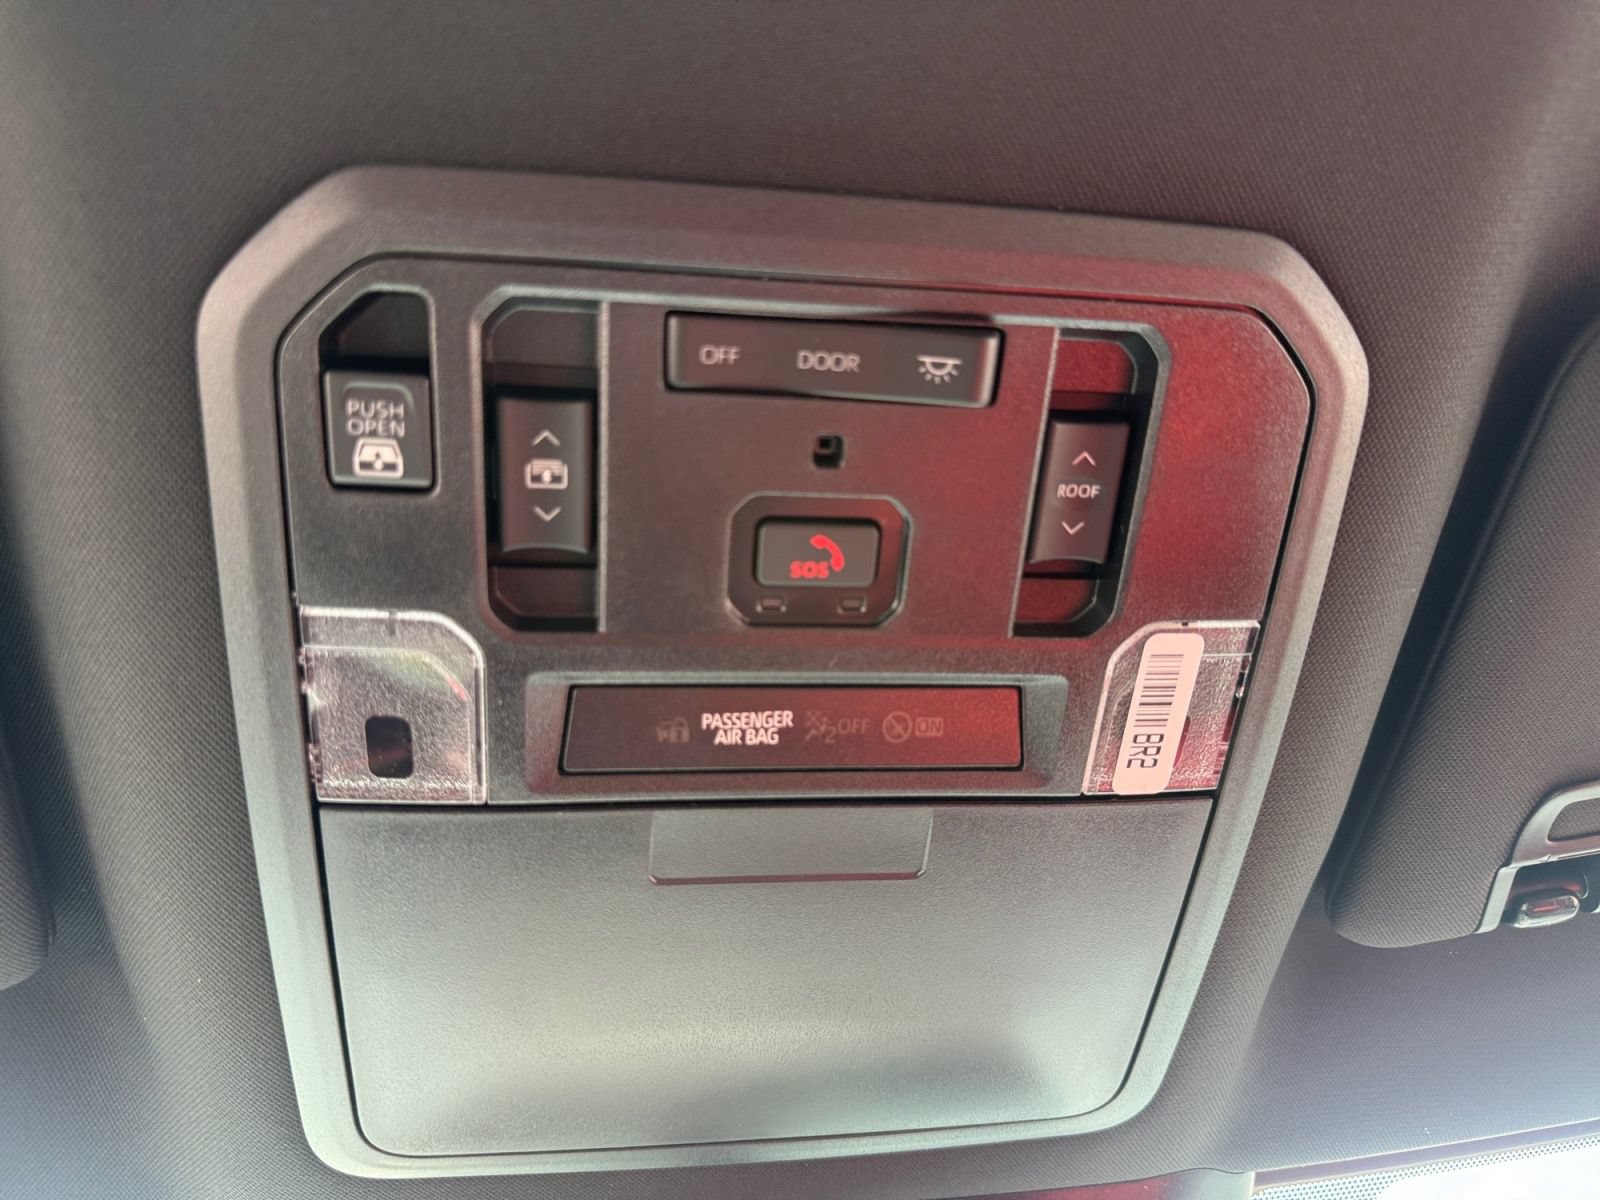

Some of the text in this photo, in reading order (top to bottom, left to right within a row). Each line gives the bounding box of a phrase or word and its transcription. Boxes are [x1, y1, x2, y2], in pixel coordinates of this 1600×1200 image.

[699, 344, 741, 366] OFF
[797, 350, 861, 373] DOOR
[345, 399, 405, 419] PUSH
[346, 418, 406, 438] OPEN
[1056, 484, 1101, 499] ROOF
[789, 560, 830, 579] SOS
[701, 710, 794, 731] PASSENGER
[837, 717, 871, 735] OFF
[916, 717, 944, 736] ON
[713, 727, 780, 746] AIR BAG
[1126, 733, 1165, 769] BR2
